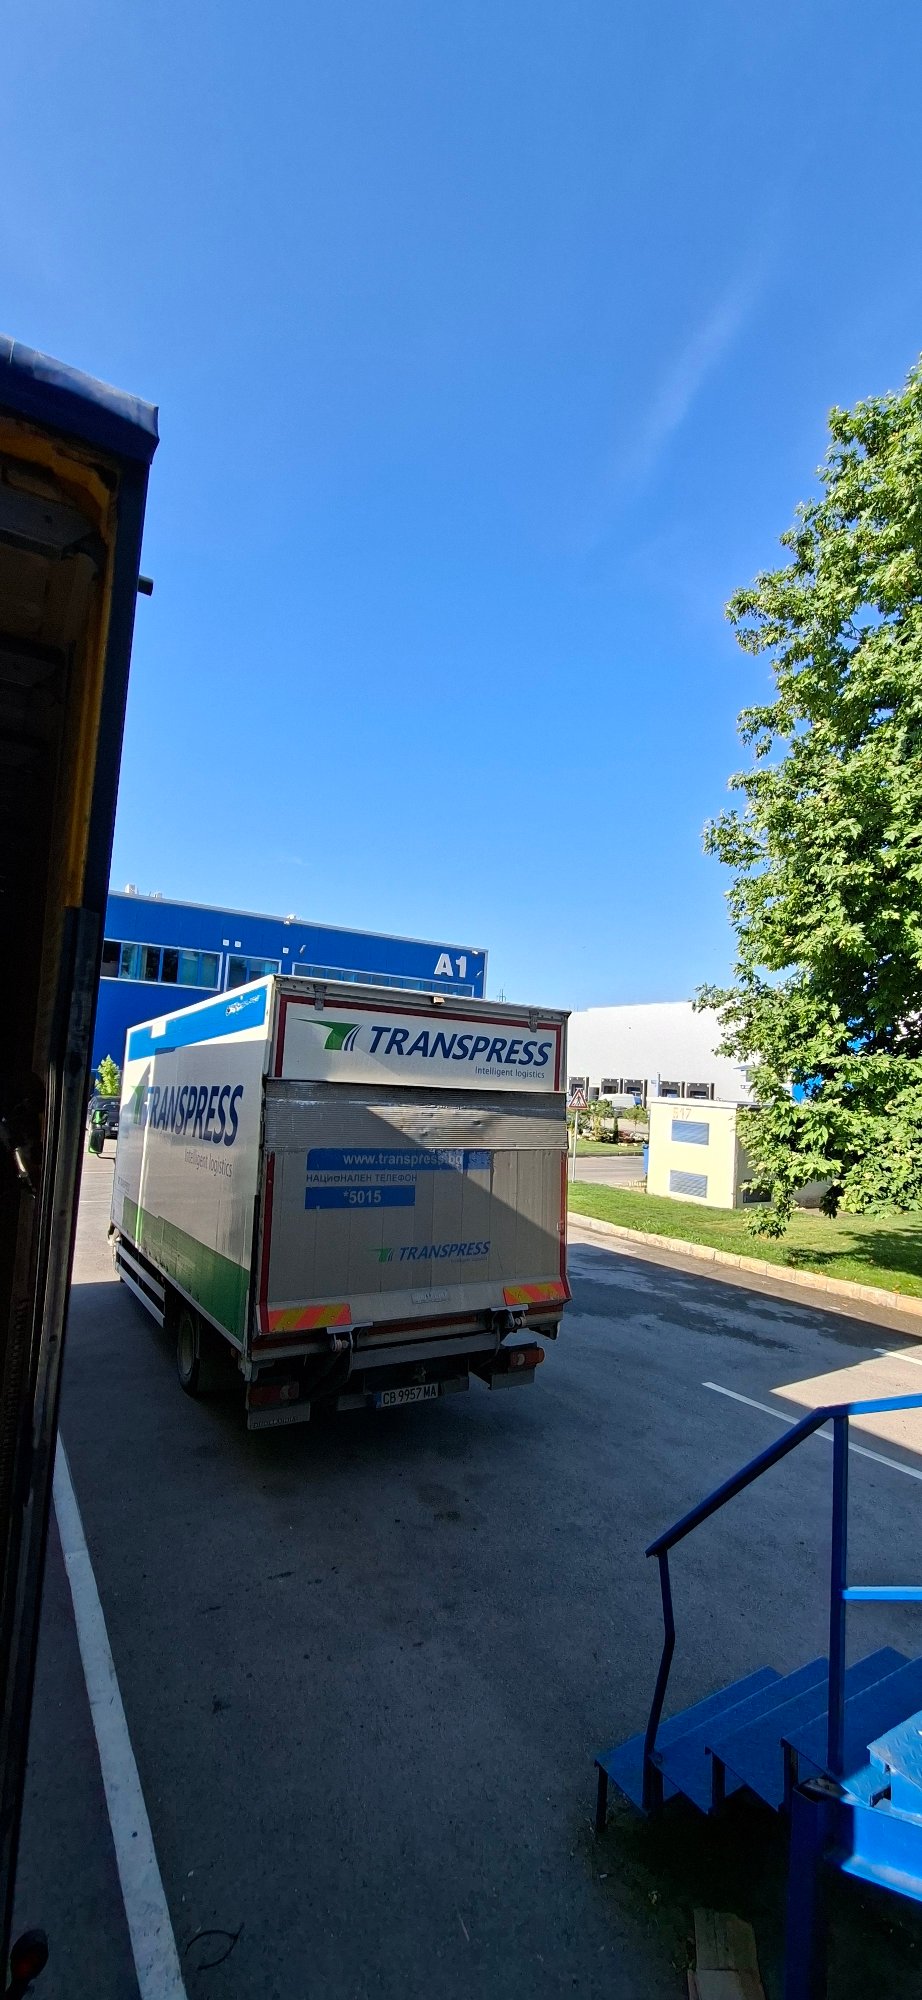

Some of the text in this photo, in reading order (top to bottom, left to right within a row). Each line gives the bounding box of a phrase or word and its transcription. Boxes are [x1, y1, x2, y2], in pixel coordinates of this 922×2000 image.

[433, 953, 467, 978] A1
[369, 1025, 552, 1066] TRANSPRESS
[475, 1066, 545, 1079] Intelligent logistics
[209, 1154, 232, 1177] logistics
[343, 1152, 463, 1167] www.transpress.bg
[375, 1173, 417, 1182] ТЕЛЕФОН
[400, 1241, 491, 1261] TRANSPRESS
[398, 1387, 422, 1402] 9957
[423, 1385, 436, 1398] MA
